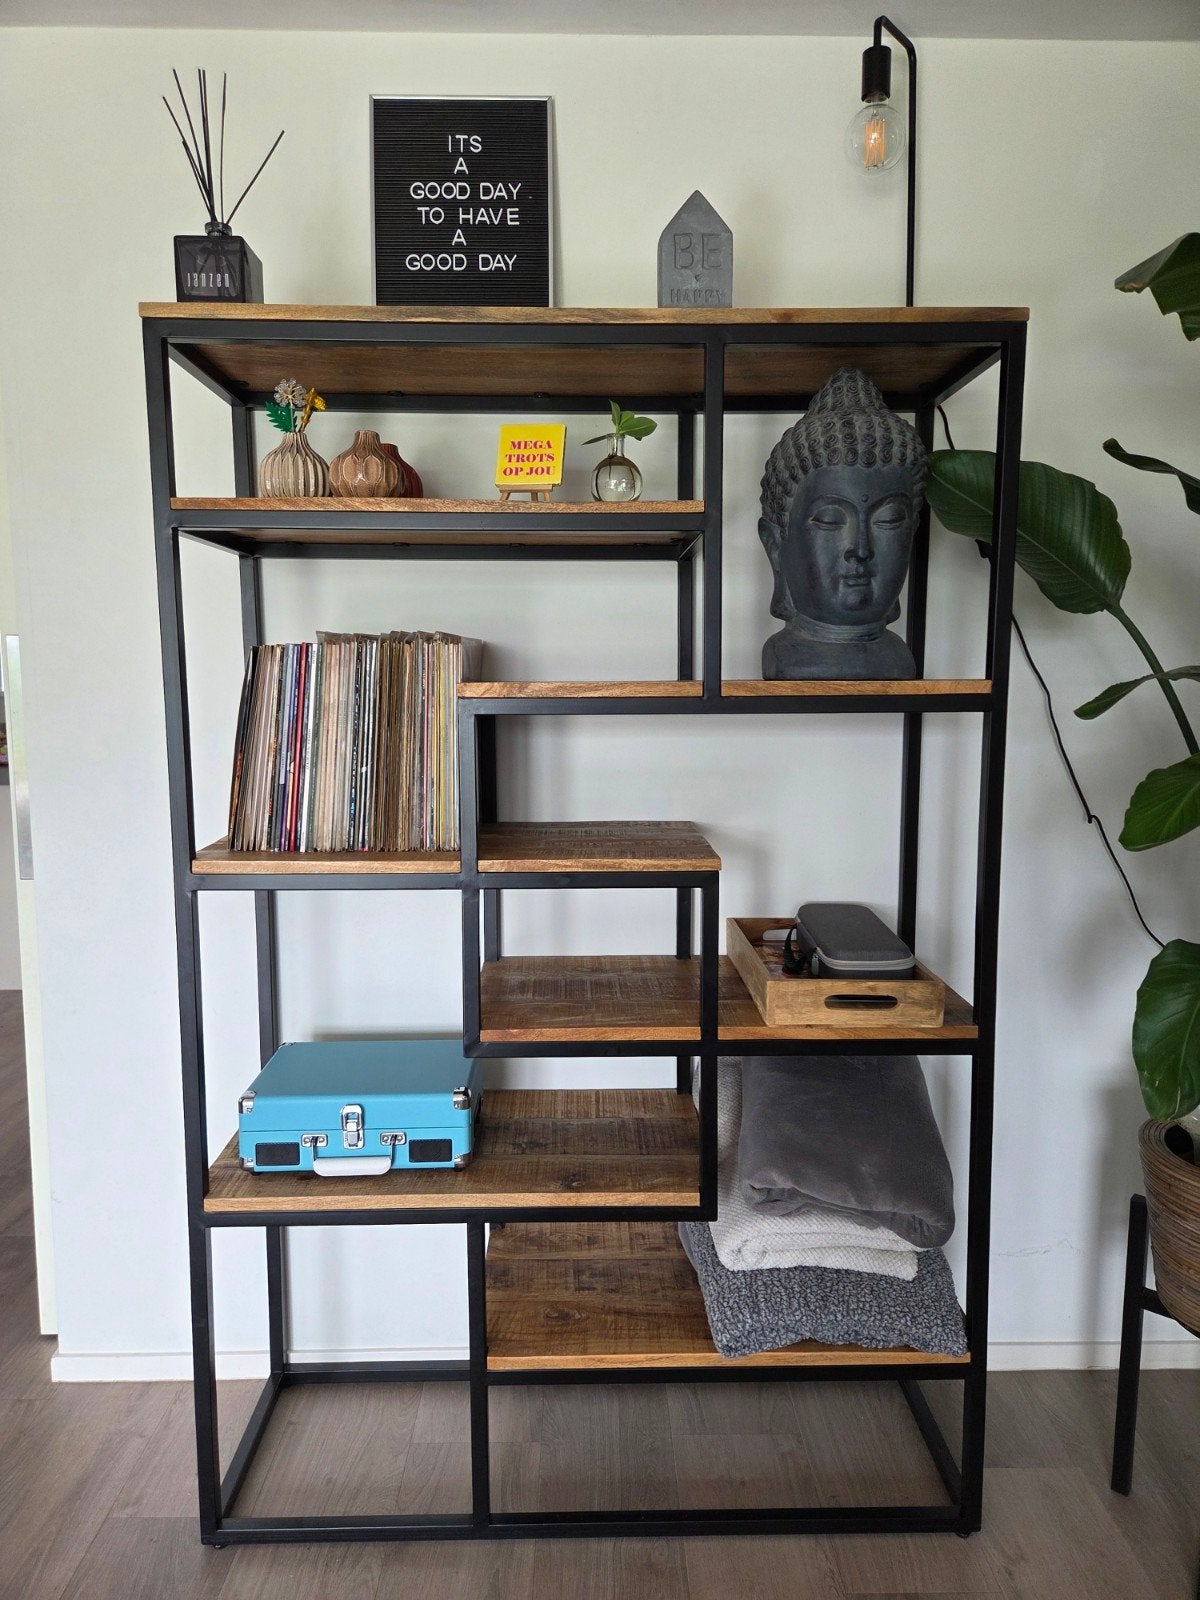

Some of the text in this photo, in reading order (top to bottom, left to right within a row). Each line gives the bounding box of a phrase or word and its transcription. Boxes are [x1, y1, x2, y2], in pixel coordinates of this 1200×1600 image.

[449, 135, 482, 152] ITS
[454, 157, 468, 174] A
[410, 182, 521, 200] GOOD DAY
[417, 207, 519, 225] TO HAVE
[452, 229, 466, 245] A
[673, 232, 722, 270] BE
[406, 254, 517, 271] GOOD DAY
[510, 440, 552, 450] MEGA
[505, 453, 555, 463] TROTS
[502, 466, 556, 476] OP JOU
